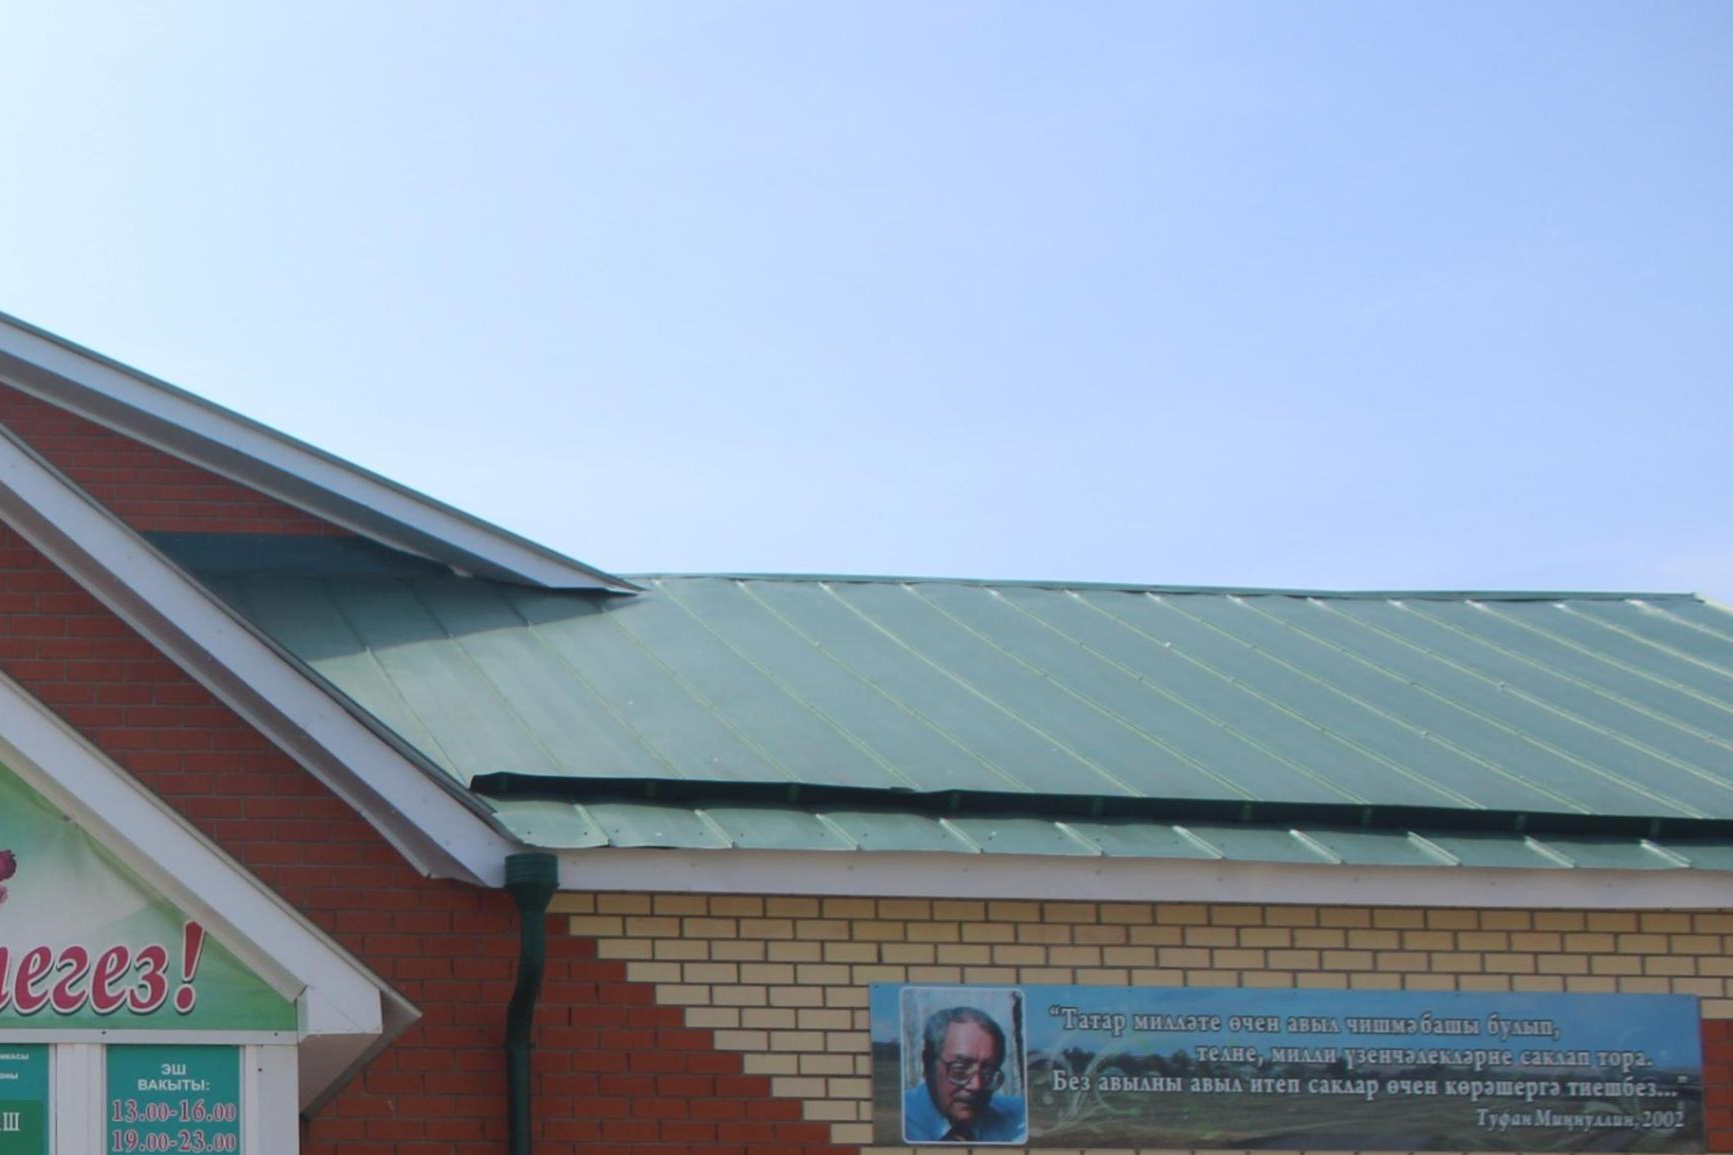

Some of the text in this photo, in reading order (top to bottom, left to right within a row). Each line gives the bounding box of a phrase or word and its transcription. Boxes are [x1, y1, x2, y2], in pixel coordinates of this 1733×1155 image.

[1050, 1006, 1125, 1036] “Татар
[1134, 1014, 1220, 1031] милләте
[1229, 1016, 1280, 1032] өчен
[1288, 1016, 1340, 1033] авыл
[1487, 1013, 1560, 1041] булып,
[161, 1063, 187, 1076] ЭШ
[1196, 1046, 1653, 1073] телне, милли үзенчәлекләрне саклап тора.
[137, 1079, 211, 1092] ВАКЫТЫ:
[1051, 1069, 1091, 1092] Без
[1099, 1075, 1183, 1093] авылны
[1190, 1076, 1243, 1093] авыл
[1250, 1077, 1301, 1094] итеп
[1308, 1077, 1379, 1100] саклар
[1387, 1078, 1438, 1095] өчен
[1446, 1079, 1561, 1102] көрәшергә
[112, 1099, 236, 1123] 13.00-16.00
[1476, 1108, 1533, 1131] Туфан
[1642, 1110, 1685, 1128] 2002
[112, 1129, 236, 1153] 19.00-23.00
